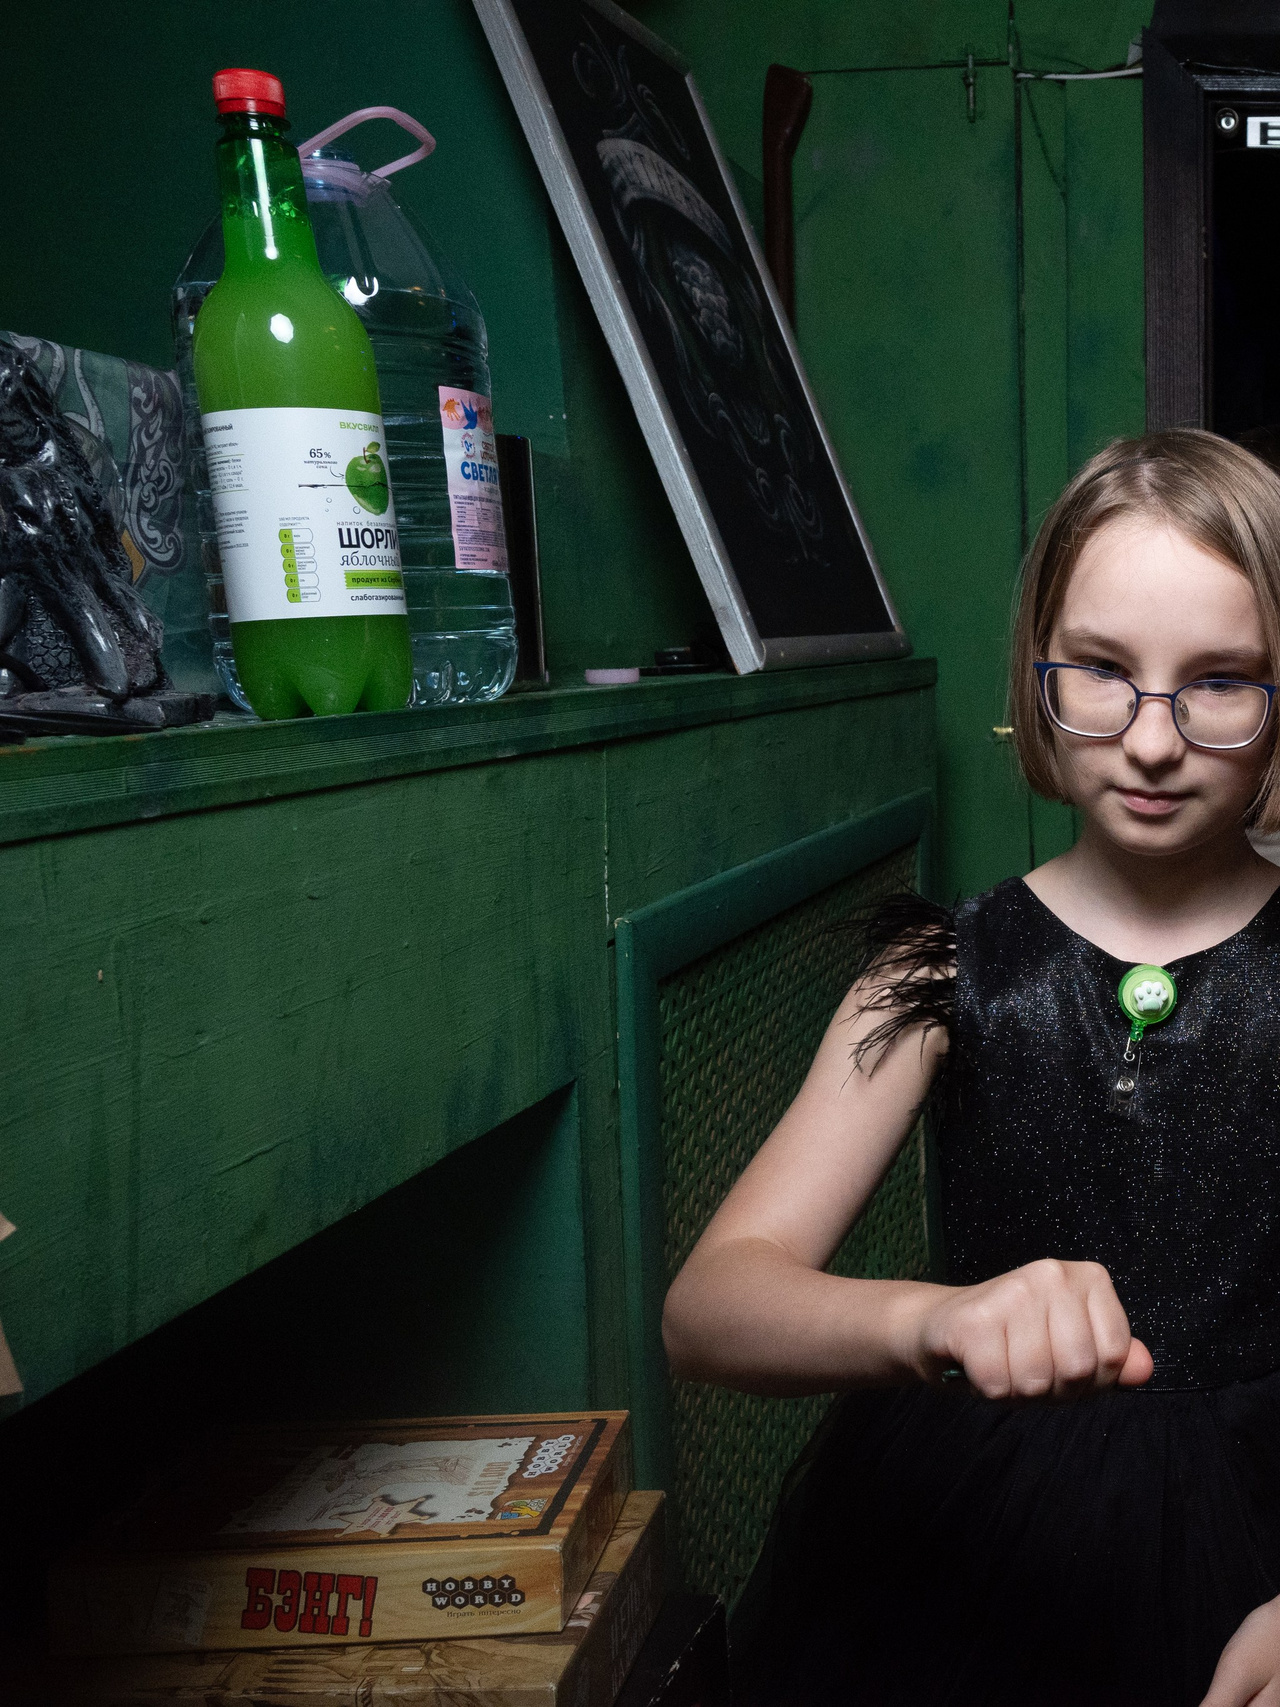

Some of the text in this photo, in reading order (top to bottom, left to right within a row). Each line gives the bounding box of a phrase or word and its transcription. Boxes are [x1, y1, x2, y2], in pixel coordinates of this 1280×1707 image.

[309, 448, 332, 459] 65%
[460, 461, 499, 486] СВЕТЛЯ
[351, 576, 380, 584] продукт
[425, 1578, 513, 1593] HOBBY
[240, 1567, 379, 1638] БЭНГ!
[433, 1592, 523, 1606] WORLD
[446, 1608, 522, 1619] Играть интересно
